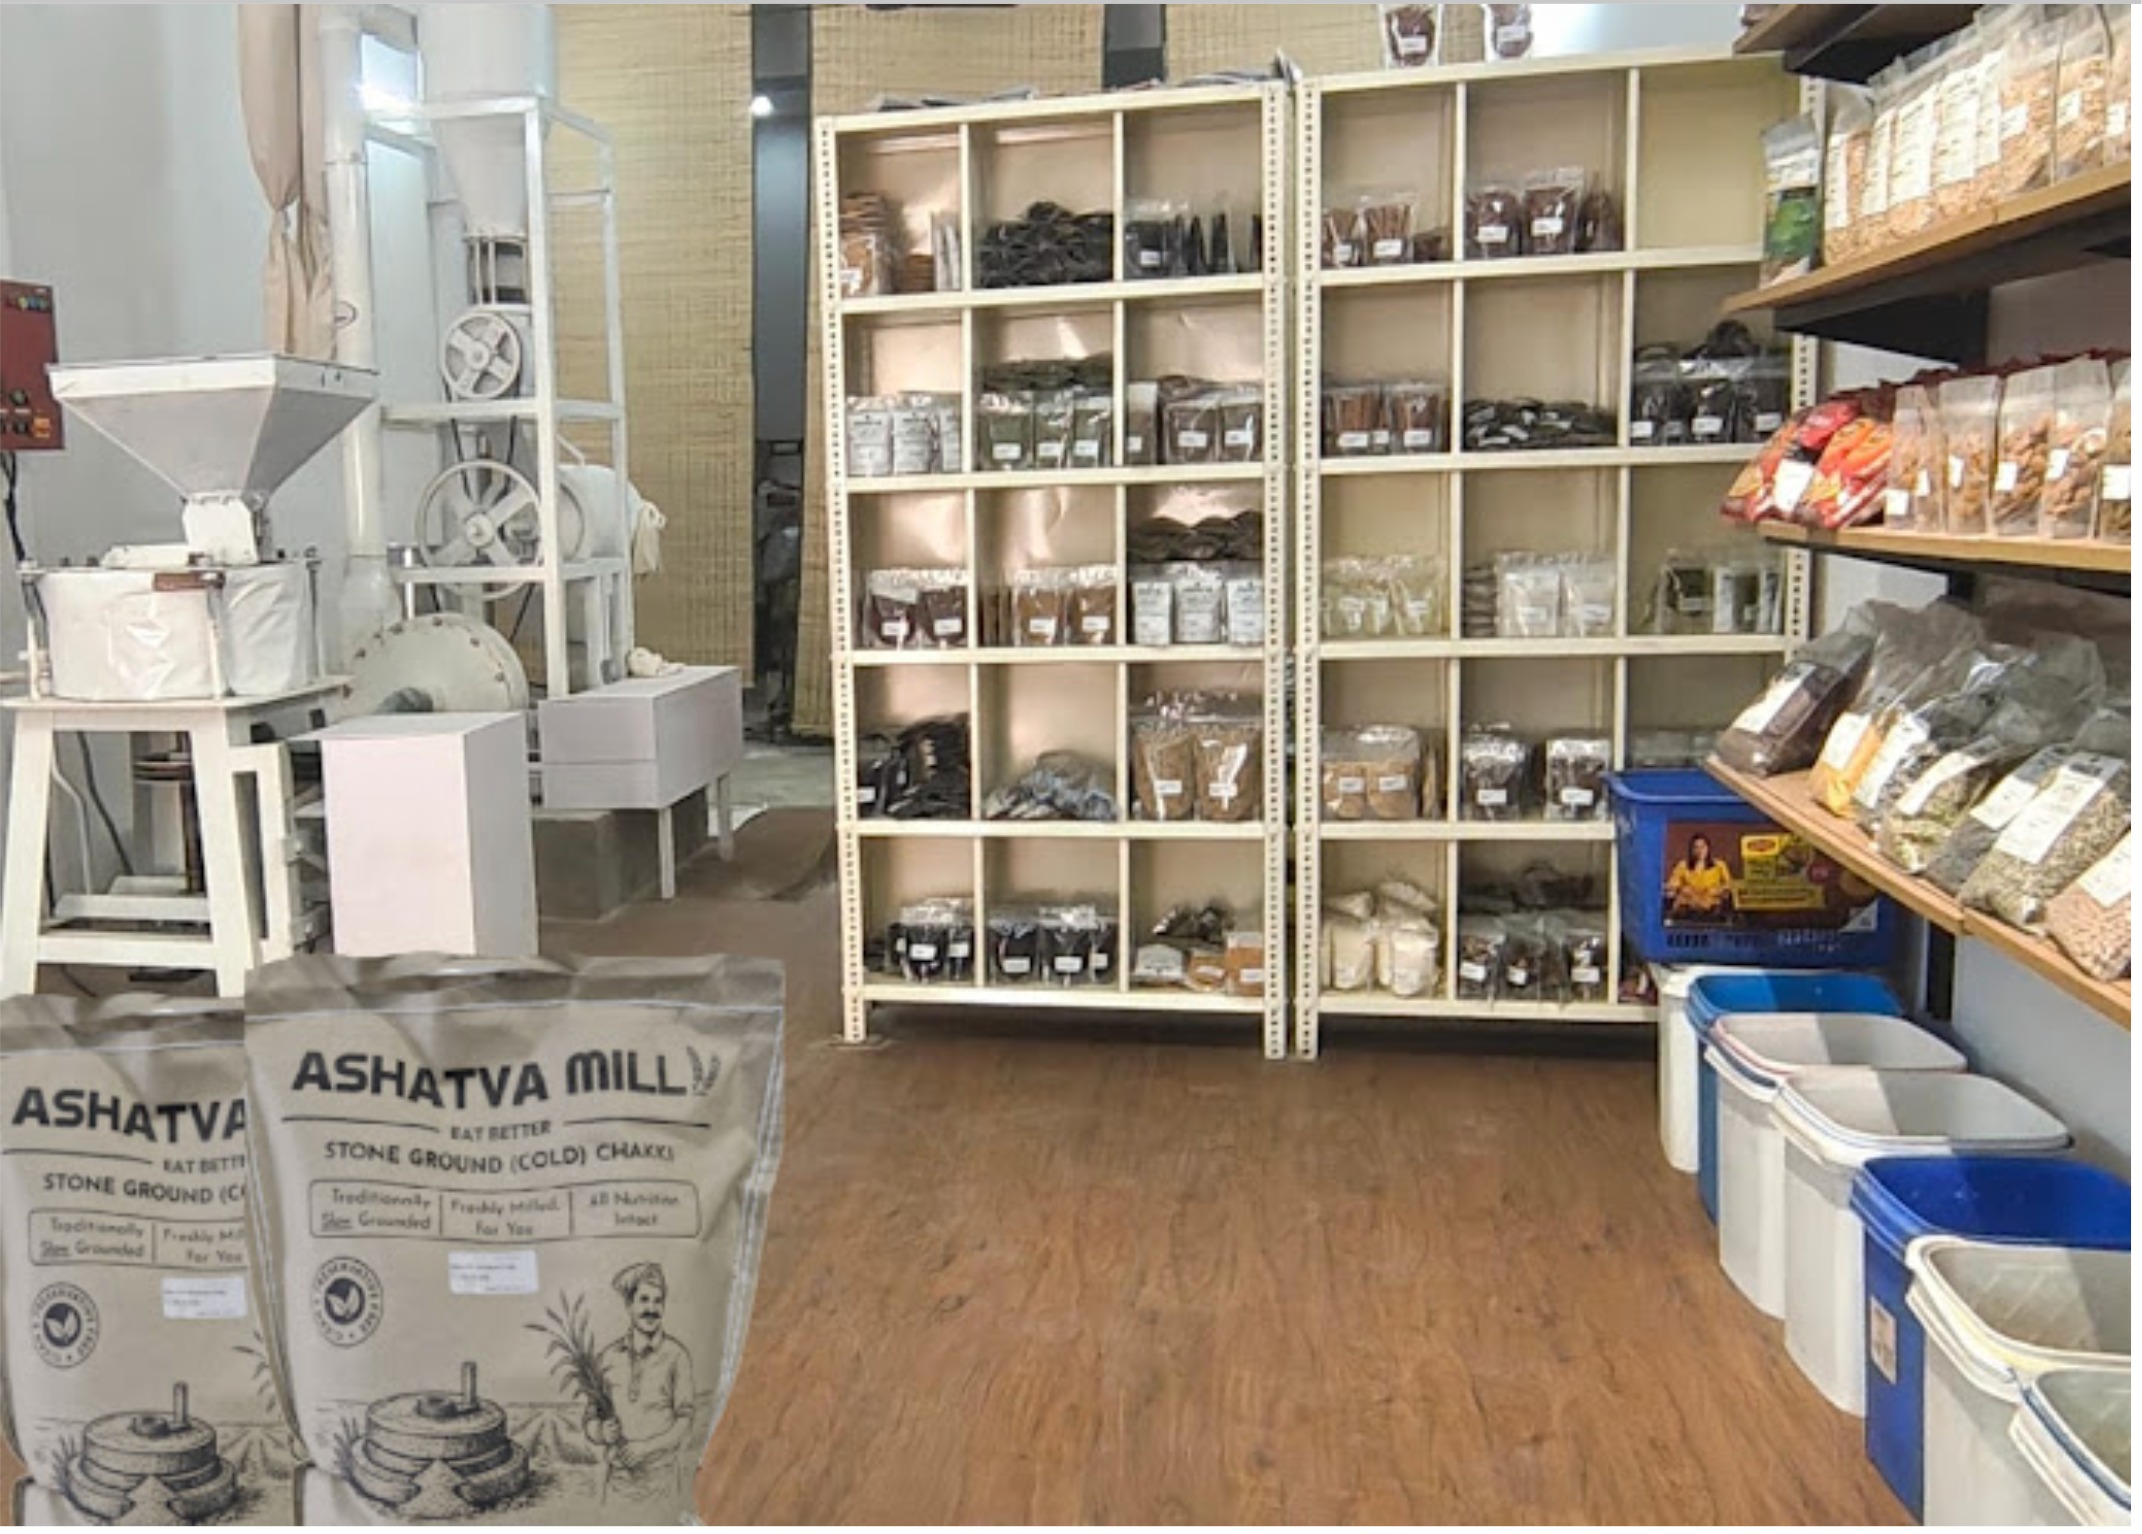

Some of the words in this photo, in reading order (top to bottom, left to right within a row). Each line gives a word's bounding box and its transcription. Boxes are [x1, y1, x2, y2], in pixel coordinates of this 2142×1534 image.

[291, 1051, 549, 1110] ASHATVA
[565, 1049, 688, 1096] MILL
[12, 1086, 246, 1143] ASHATVA
[450, 1126, 485, 1142] EAT
[488, 1120, 552, 1142] BETTER
[163, 1157, 195, 1174] EAT
[324, 1141, 401, 1166] STONE
[408, 1148, 503, 1175] GROUND
[510, 1145, 588, 1174] (COLD)
[596, 1141, 675, 1163] CHAKKI
[43, 1172, 117, 1196] STONE
[123, 1178, 215, 1206] GROUND
